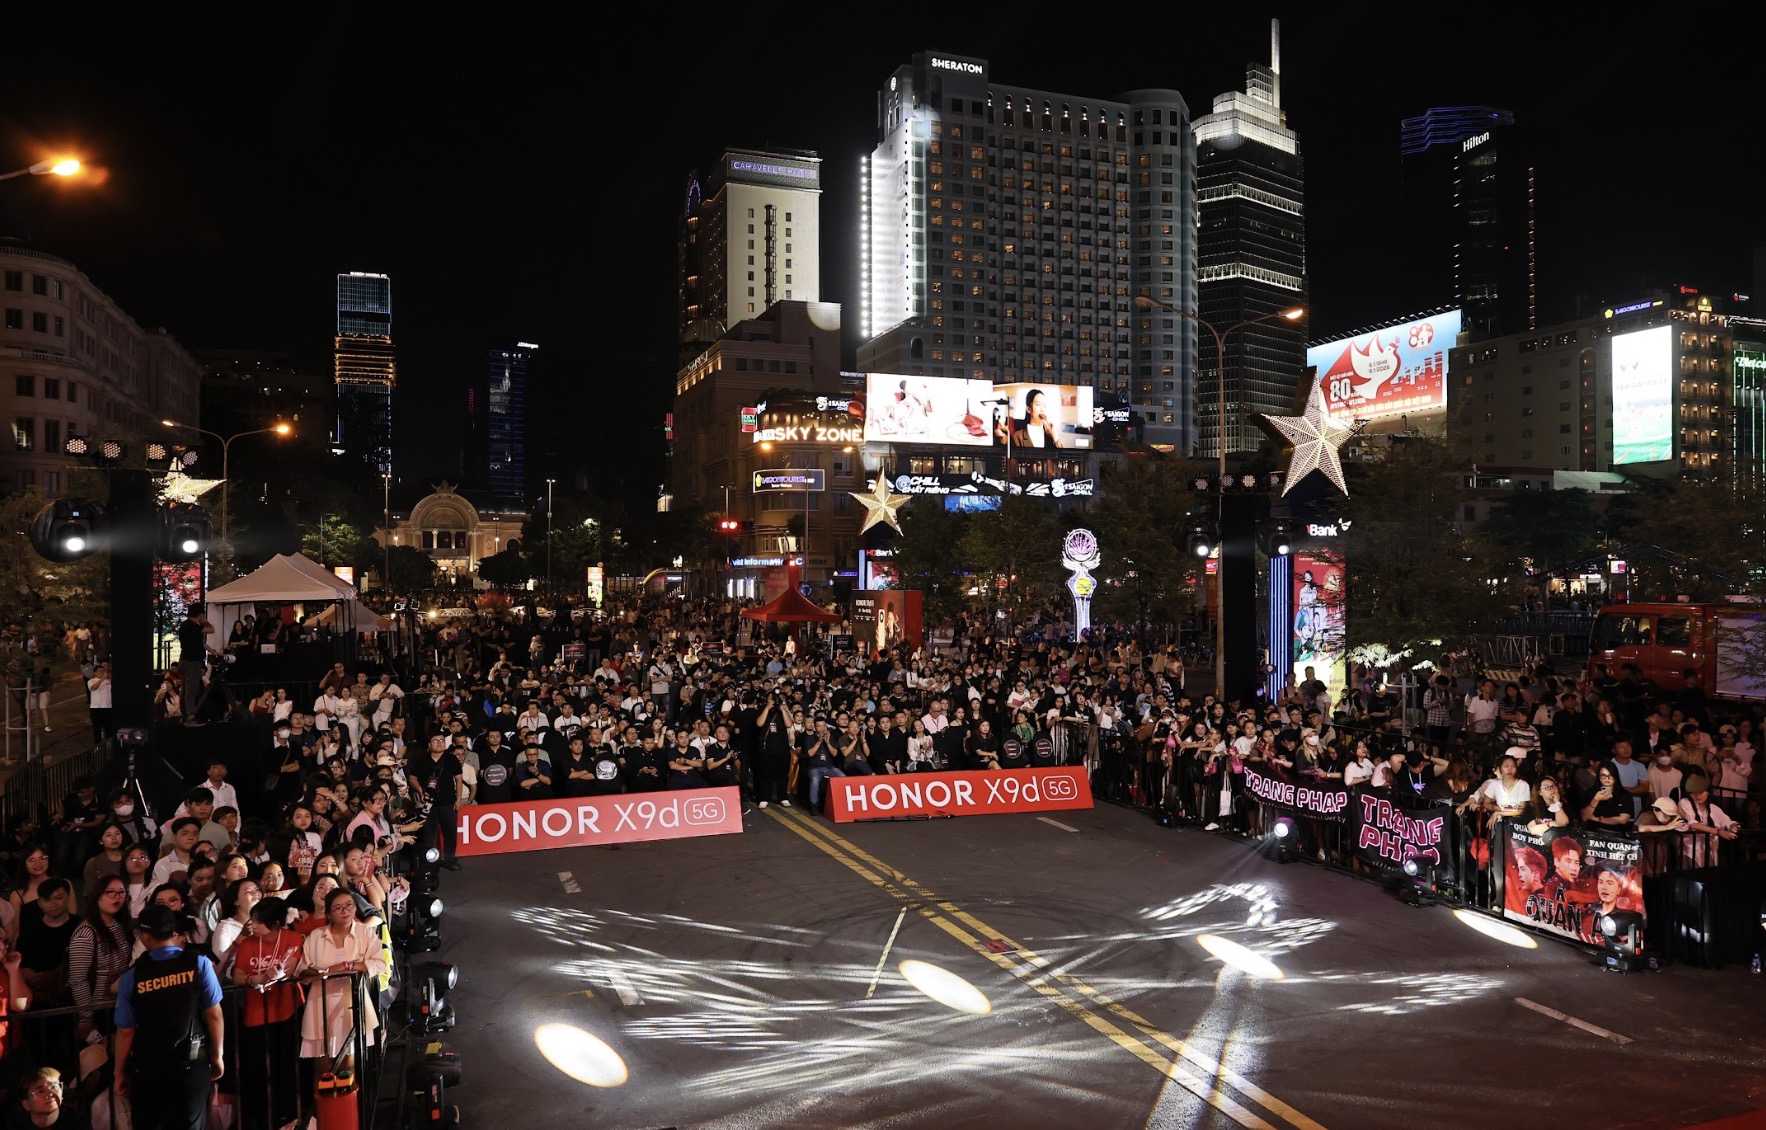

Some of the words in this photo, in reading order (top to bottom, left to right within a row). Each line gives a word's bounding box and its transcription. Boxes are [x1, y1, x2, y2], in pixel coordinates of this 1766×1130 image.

[931, 57, 983, 74] SHERATON
[1462, 131, 1490, 152] Hilton
[733, 161, 782, 174] CARAVELLE
[1329, 377, 1352, 402] 80
[775, 426, 811, 441] SKY
[815, 427, 863, 442] ZONE
[910, 476, 940, 486] CHILL
[844, 780, 976, 812] HONOR
[984, 776, 1041, 805] X9d
[1049, 780, 1071, 796] 5G
[1243, 766, 1294, 806] TRANG
[1297, 787, 1348, 814] PHAP
[457, 805, 602, 844] HONOR
[613, 798, 680, 832] X9d
[691, 803, 719, 820] 5G
[1360, 793, 1444, 846] TRANG
[1512, 832, 1527, 841] BOY
[1589, 839, 1606, 849] FAN
[1586, 849, 1607, 858] XINH
[1626, 852, 1638, 860] CH
[137, 970, 196, 994] SECURITY
